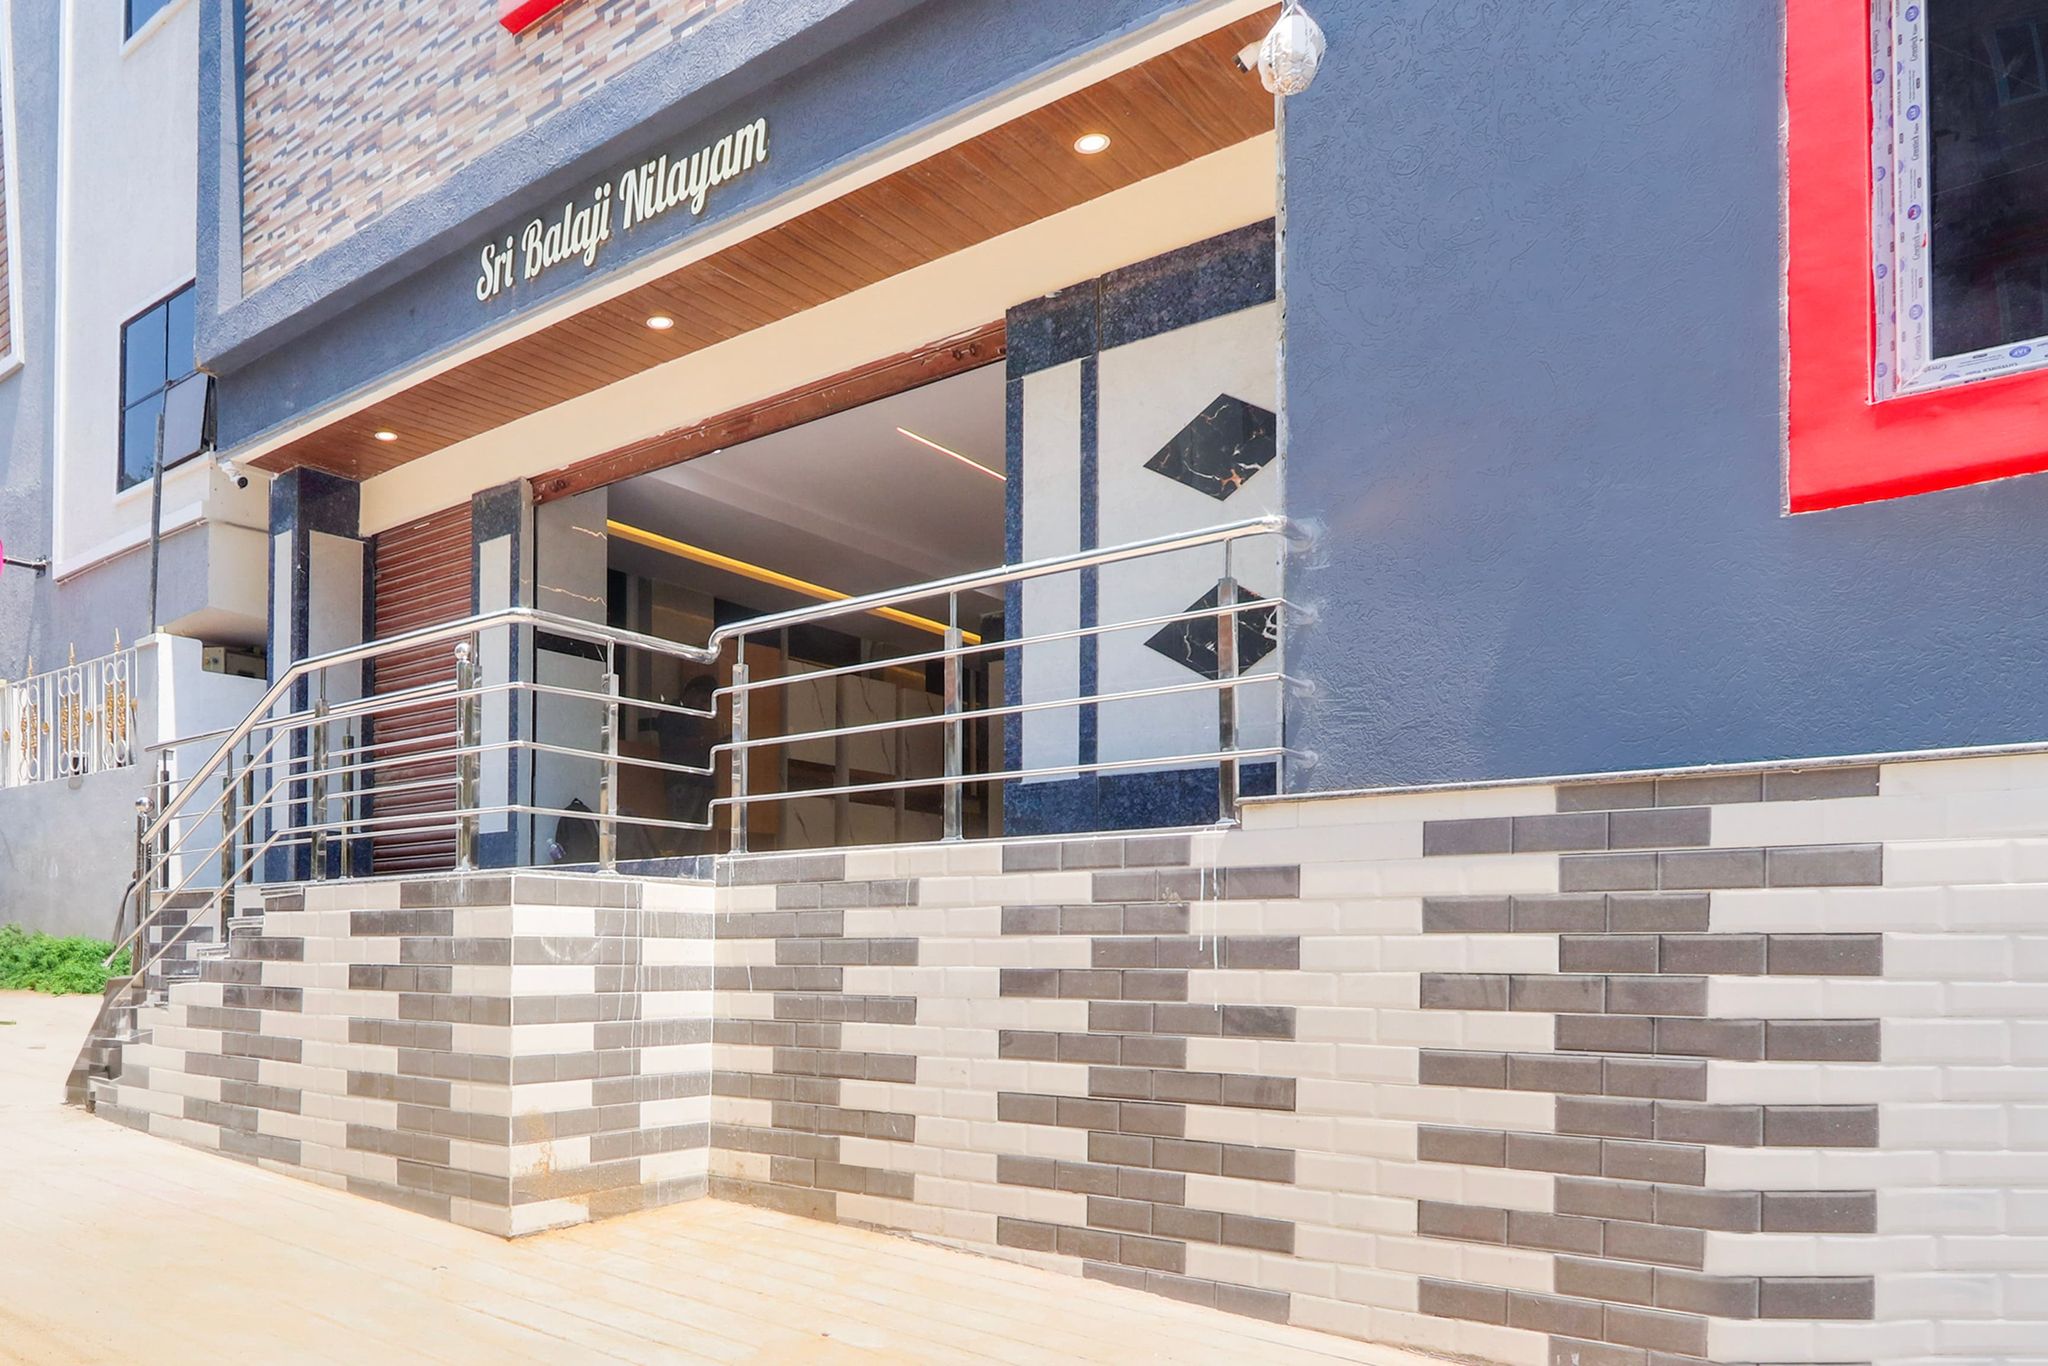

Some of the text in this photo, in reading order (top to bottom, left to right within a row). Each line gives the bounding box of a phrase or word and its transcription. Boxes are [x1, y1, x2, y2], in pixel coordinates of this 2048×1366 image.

[476, 116, 768, 301] Sri Balaji Nilayam
